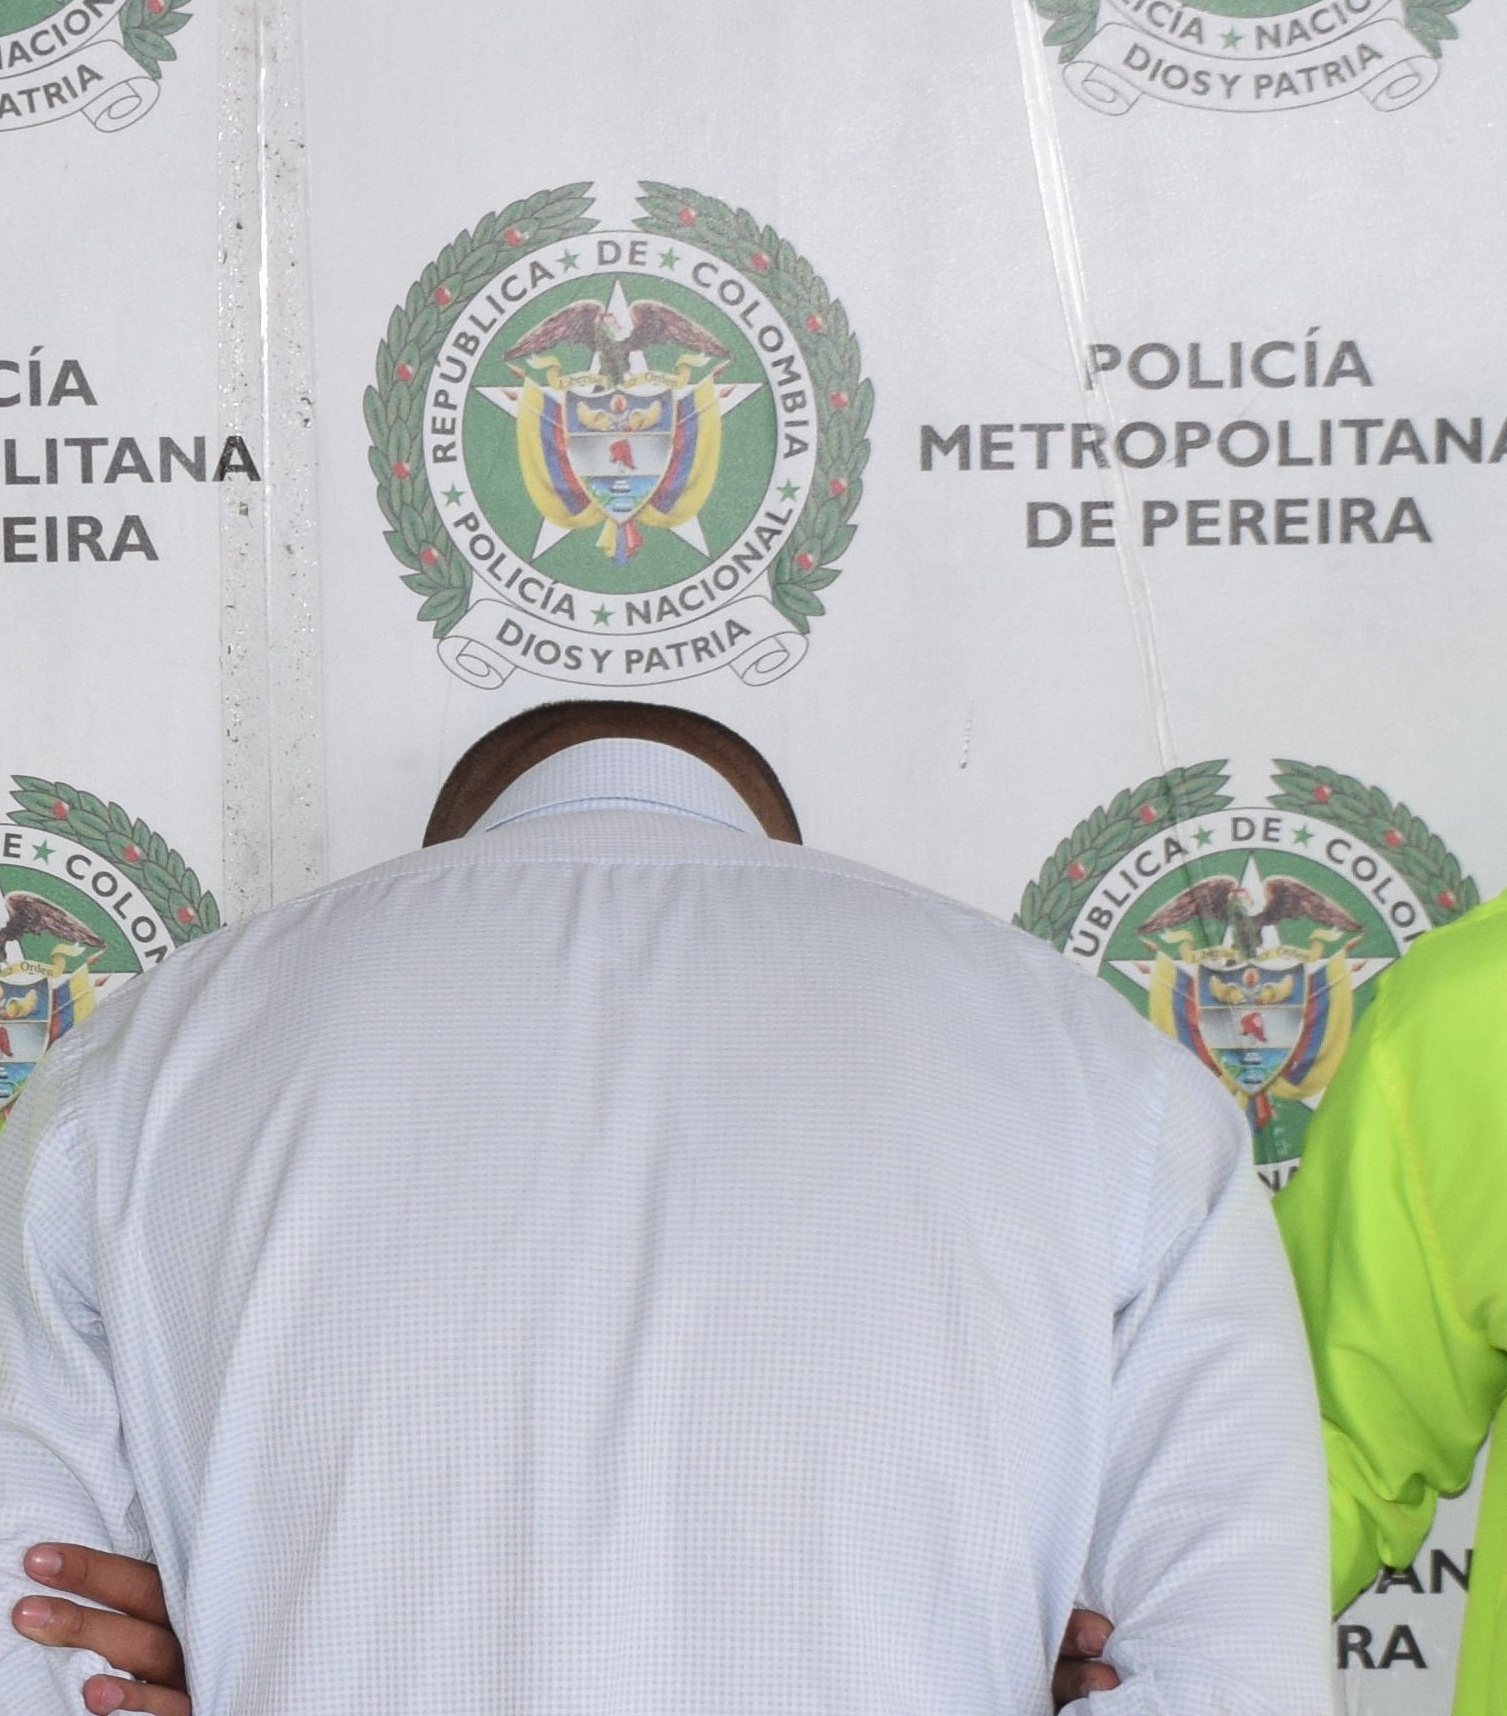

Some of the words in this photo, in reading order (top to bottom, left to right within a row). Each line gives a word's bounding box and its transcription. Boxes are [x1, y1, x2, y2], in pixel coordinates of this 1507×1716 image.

[1122, 43, 1212, 97] DIOS
[1254, 43, 1384, 100] PATRIA
[432, 260, 556, 464] REPÚBLICA
[596, 239, 648, 266] DE
[691, 261, 810, 460] COLOMBIA
[1085, 327, 1374, 389] POLICÍA
[1026, 501, 1116, 547] DE
[1143, 497, 1433, 546] PEREIRA
[452, 511, 576, 621] POLICÍA
[624, 506, 793, 627] NACIONAL
[495, 618, 584, 672] DIOS
[624, 617, 752, 675] PATRIA
[1231, 817, 1282, 843] DE
